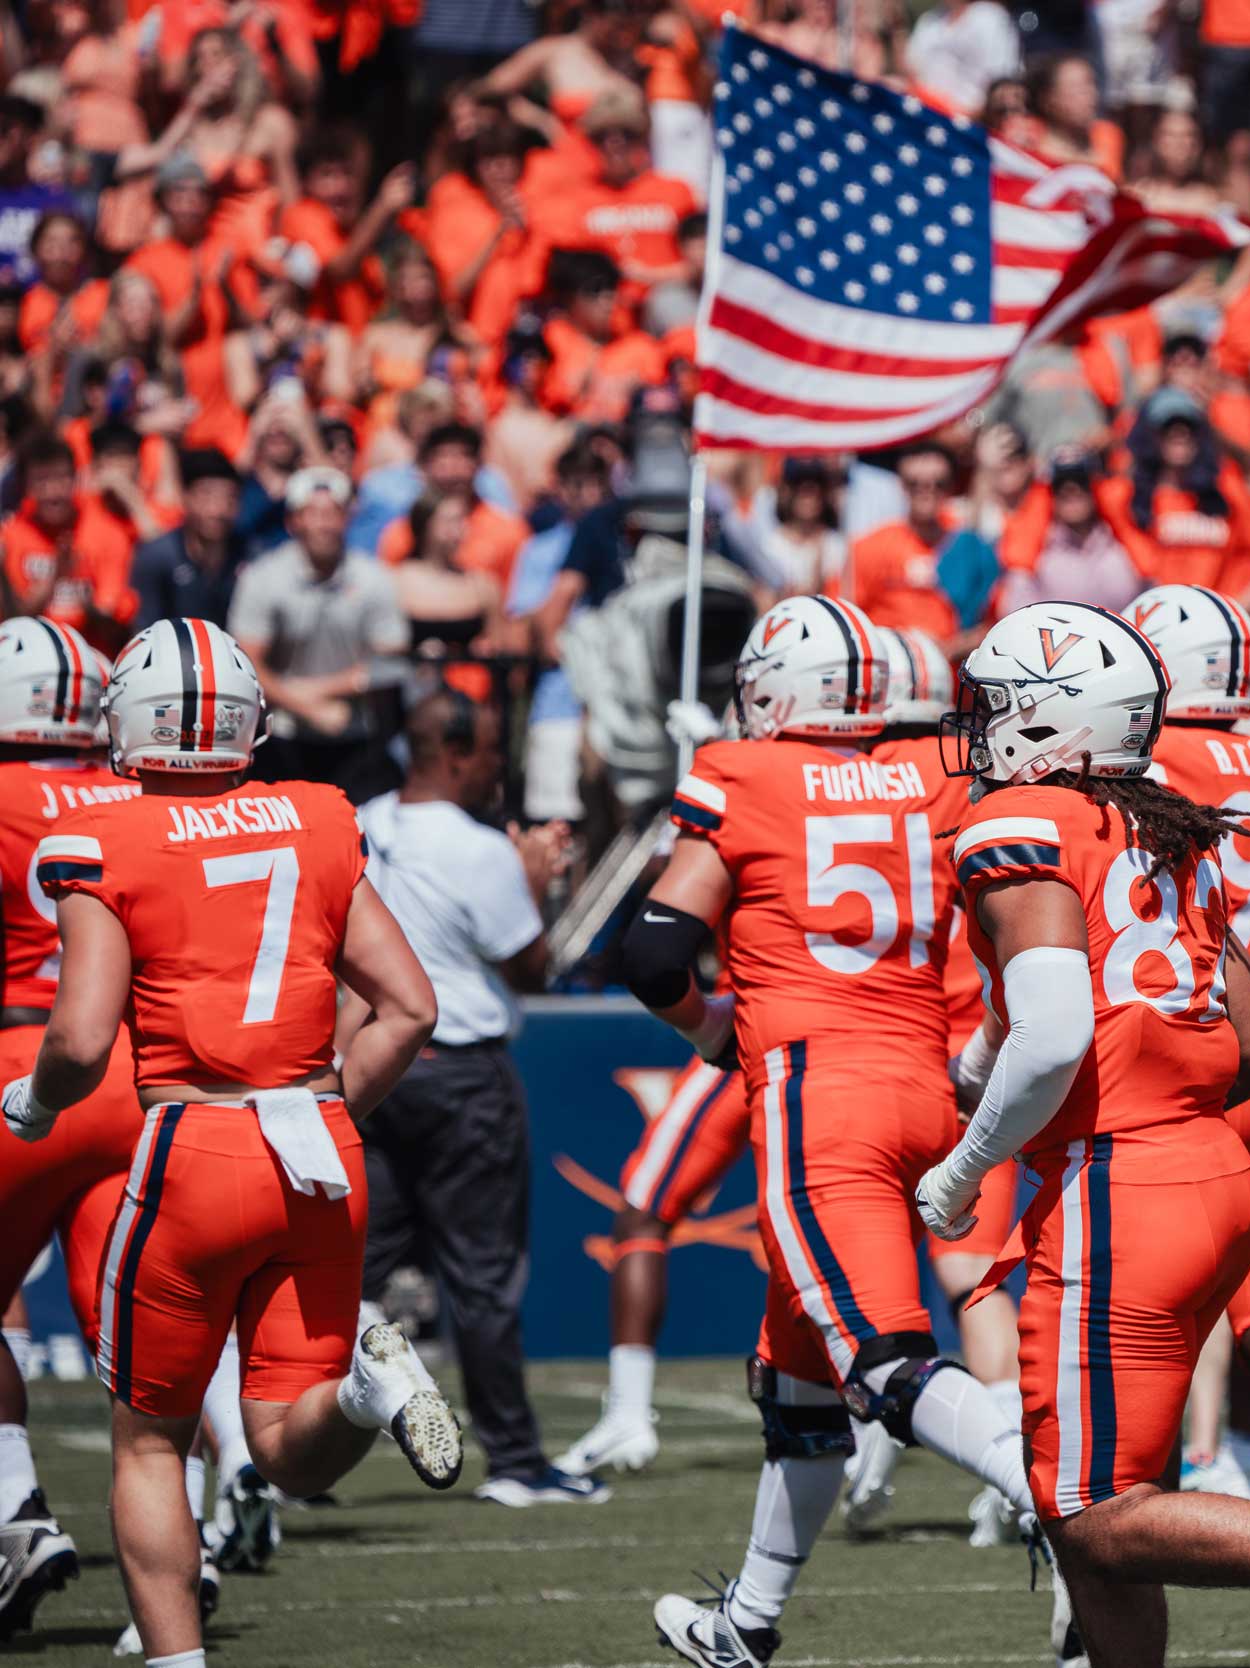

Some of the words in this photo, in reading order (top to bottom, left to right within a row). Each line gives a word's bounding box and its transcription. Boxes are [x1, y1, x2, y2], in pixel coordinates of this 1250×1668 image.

[142, 756, 166, 768] FOR
[168, 757, 191, 769] ALL
[1098, 765, 1125, 776] FOR
[1205, 739, 1239, 775] B.
[802, 760, 926, 801] FURNISH
[167, 795, 303, 842] JACKSON
[805, 813, 935, 974] 51
[202, 846, 300, 1024] 7
